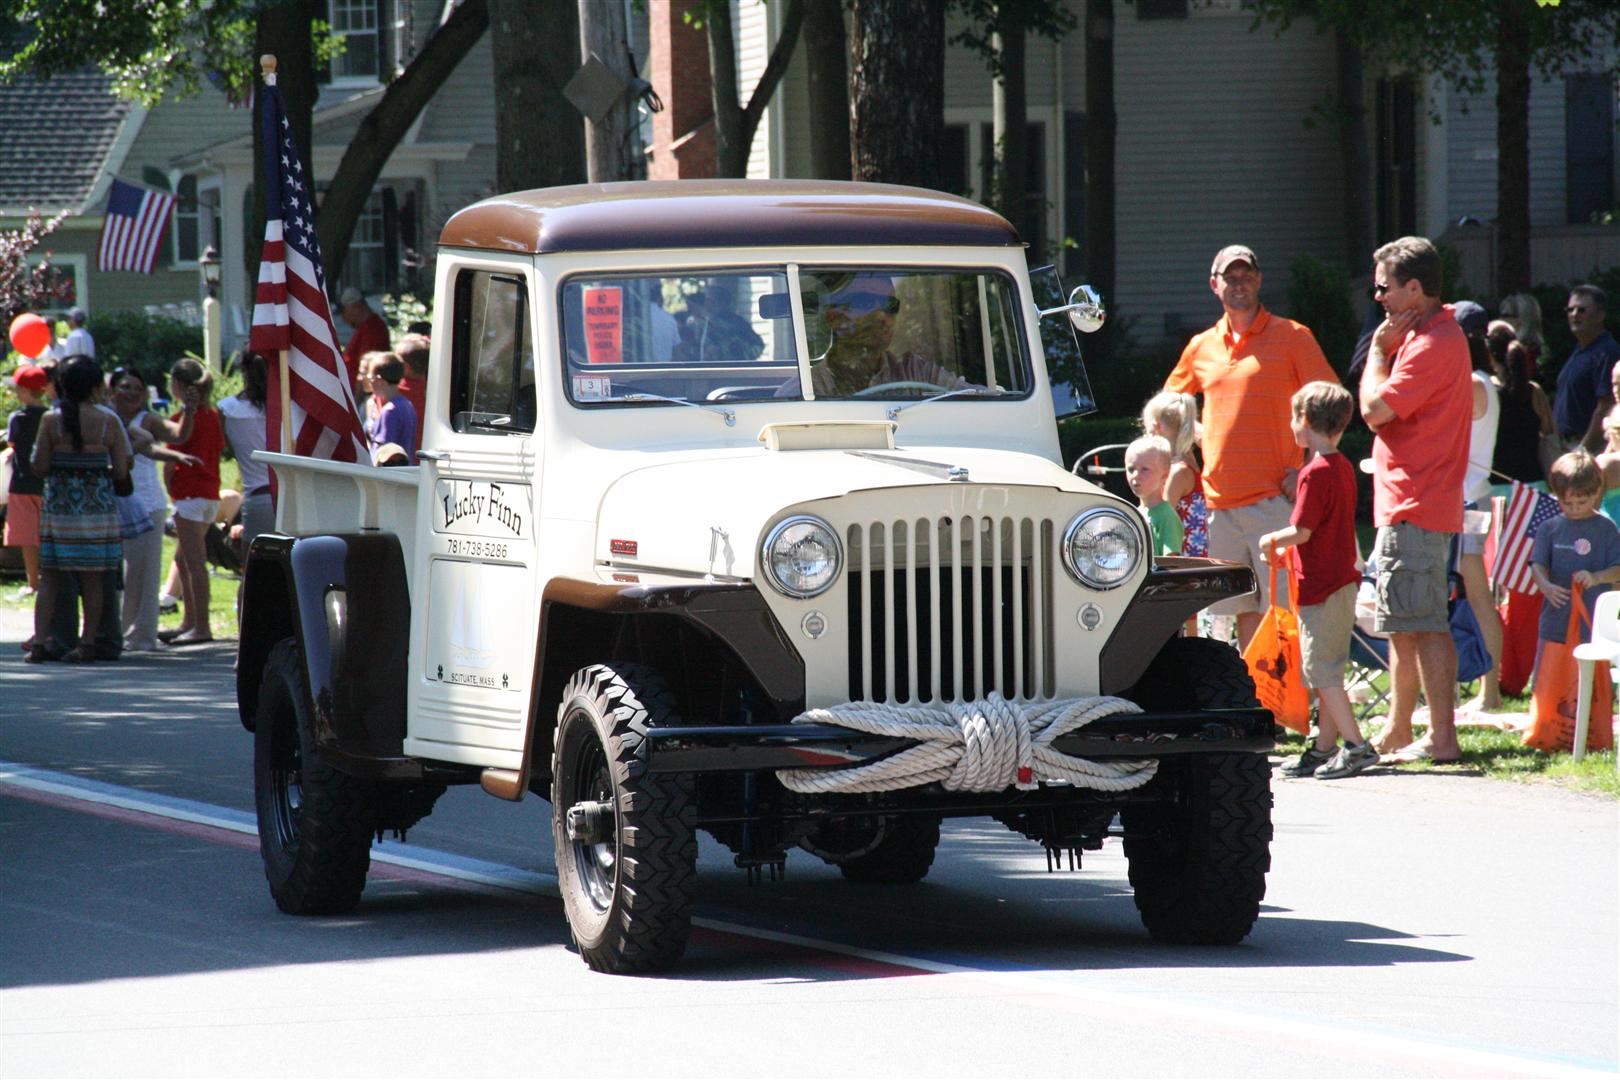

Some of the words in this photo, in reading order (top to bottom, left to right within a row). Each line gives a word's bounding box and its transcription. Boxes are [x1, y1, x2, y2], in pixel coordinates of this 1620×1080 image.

[443, 481, 485, 528] Lucky
[487, 483, 522, 536] Finn
[447, 539, 508, 558] 781-738-5286
[479, 676, 496, 687] MASS
